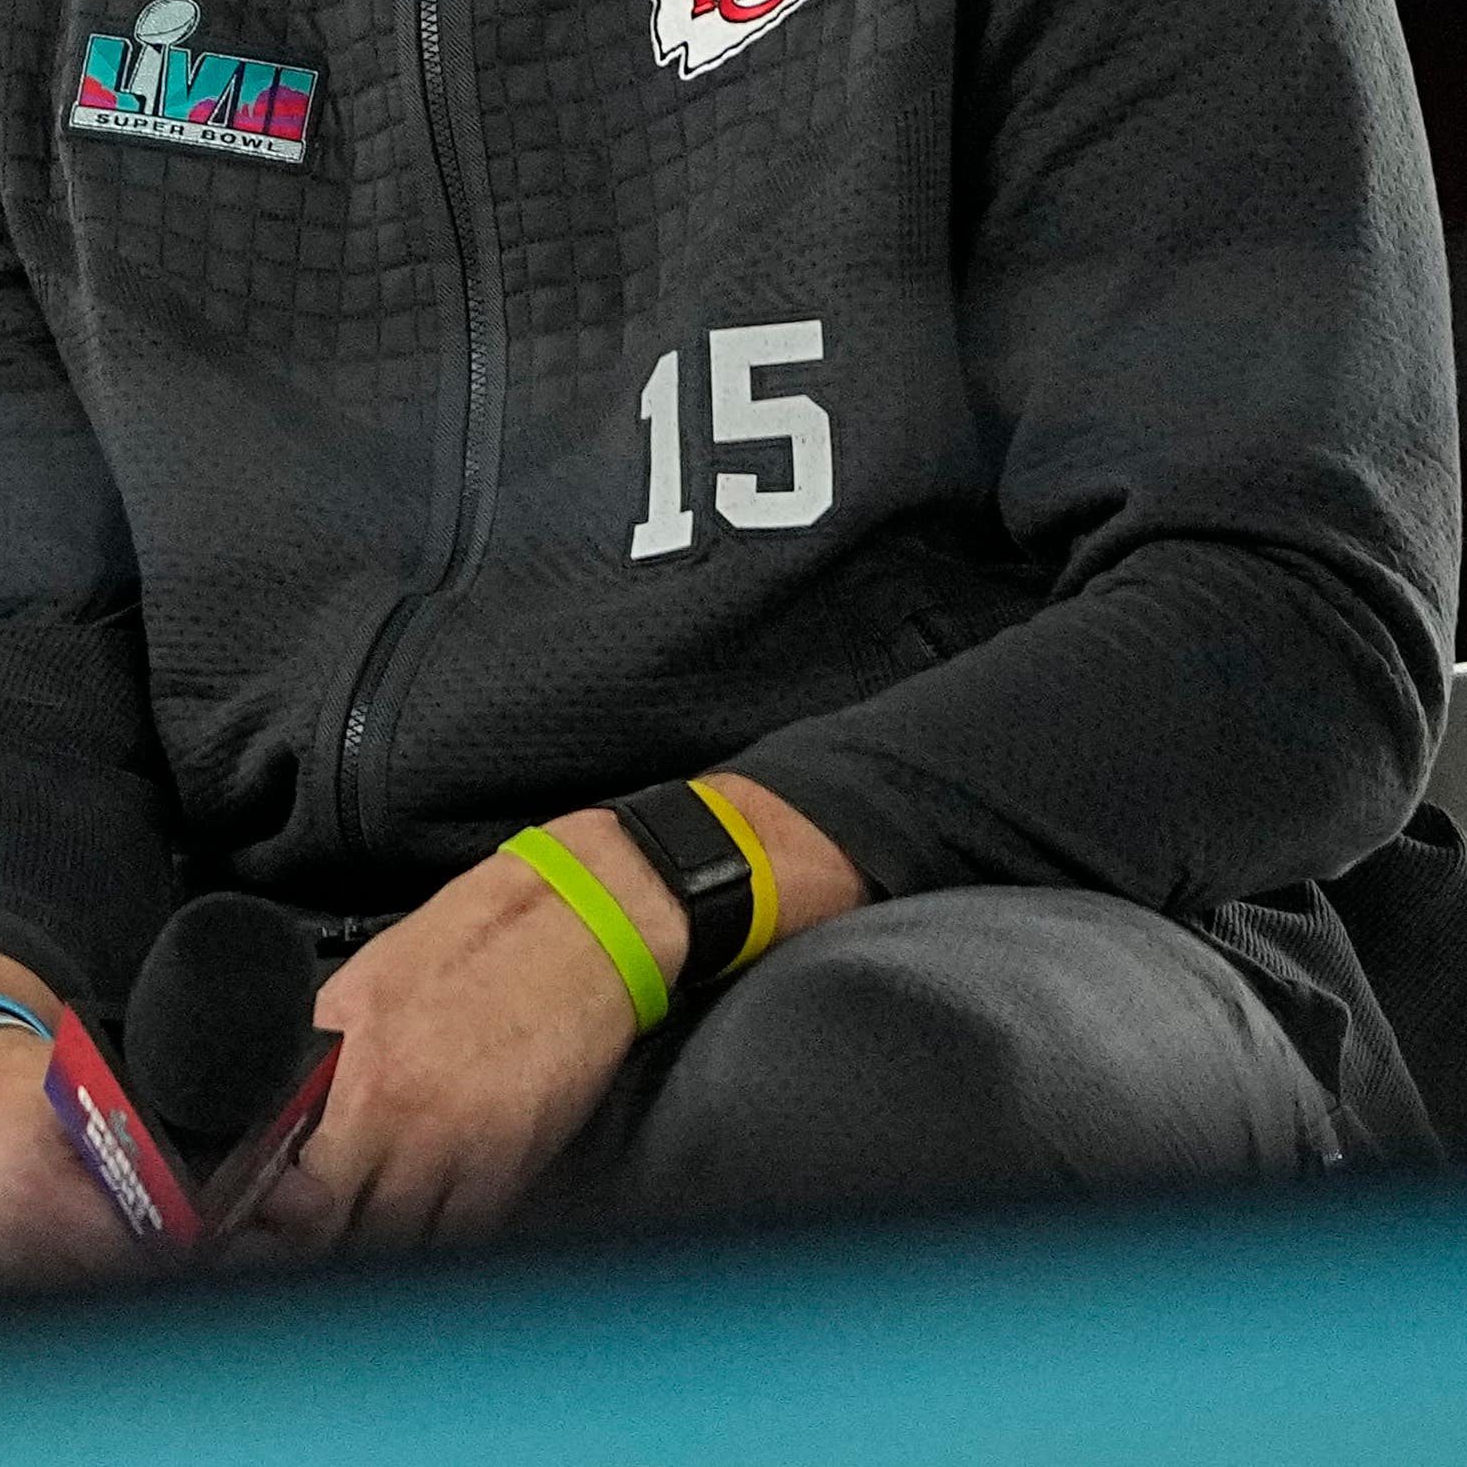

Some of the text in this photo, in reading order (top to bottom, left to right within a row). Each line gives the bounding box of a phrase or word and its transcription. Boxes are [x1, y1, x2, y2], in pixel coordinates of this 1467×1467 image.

[95, 113, 278, 152] SUPER BOWL
[630, 319, 834, 561] 15
